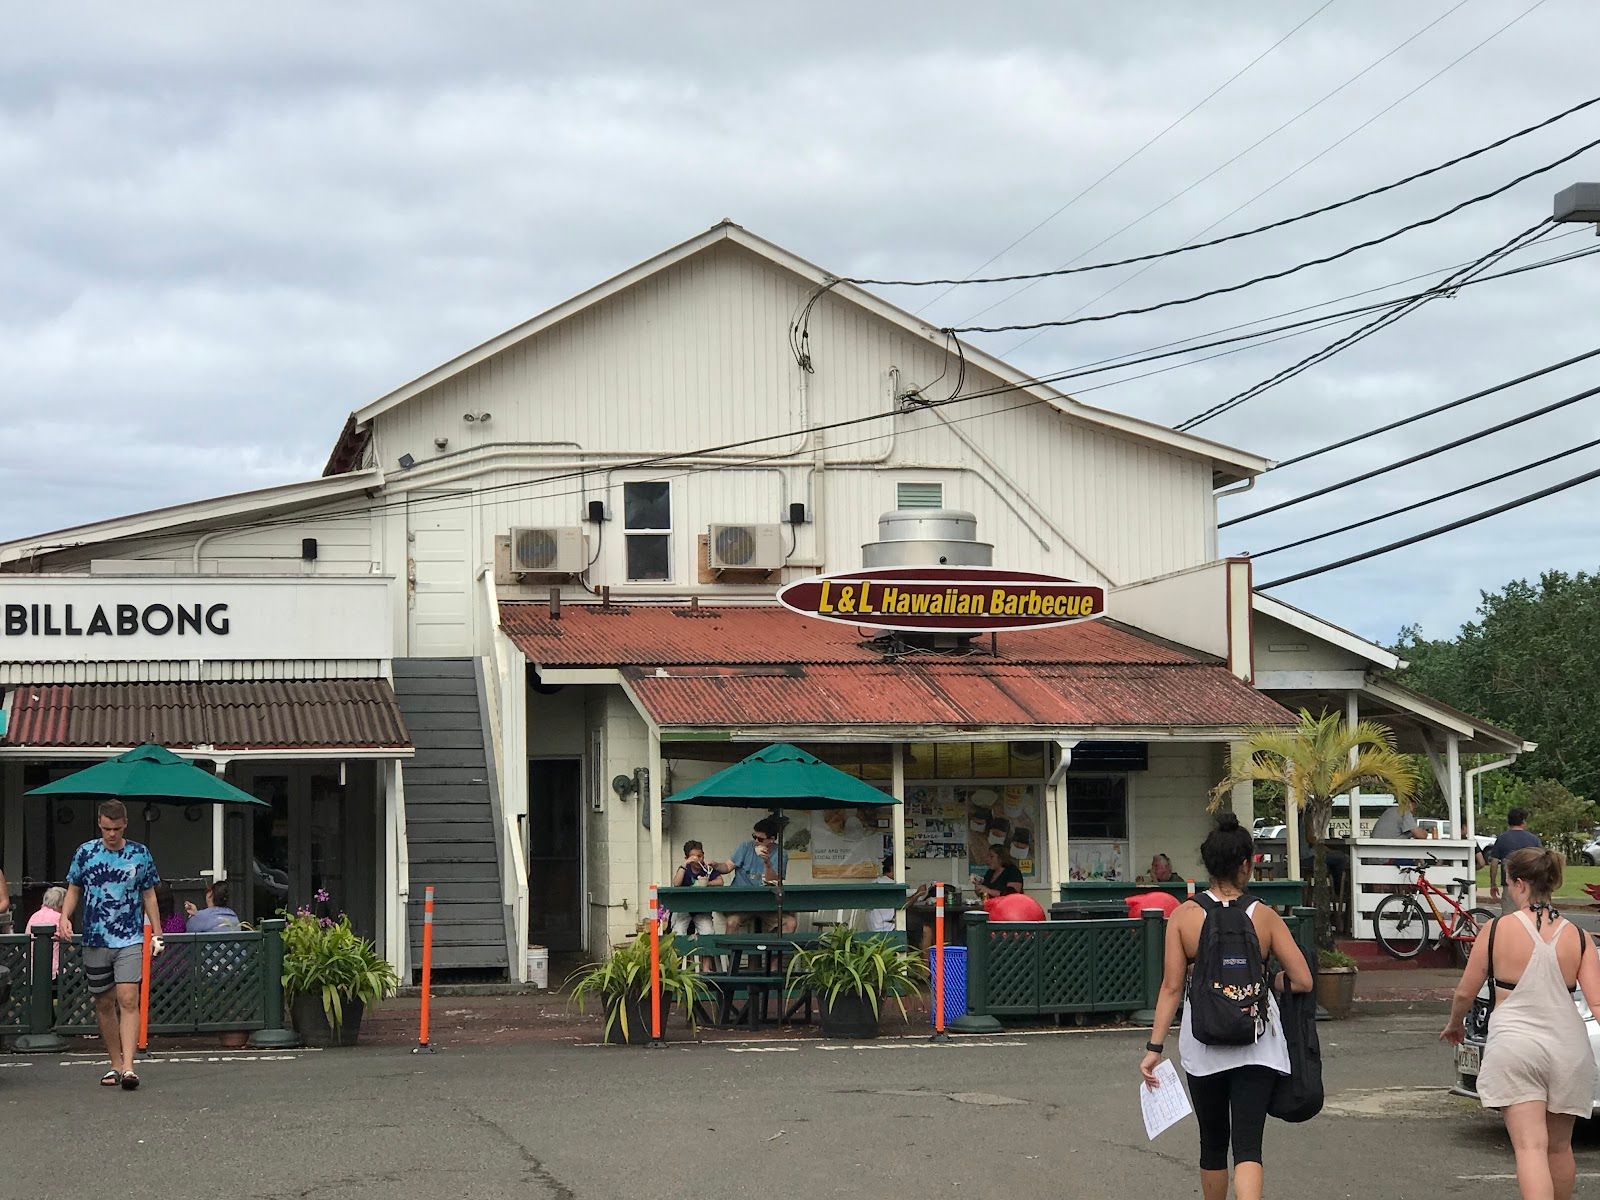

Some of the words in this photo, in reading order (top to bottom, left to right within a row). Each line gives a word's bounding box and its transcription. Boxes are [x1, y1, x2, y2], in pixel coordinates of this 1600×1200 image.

[817, 581, 873, 614] L&L
[881, 587, 984, 615] Hawaiian
[989, 589, 1094, 617] Barbecue
[5, 603, 229, 636] BILLABONG
